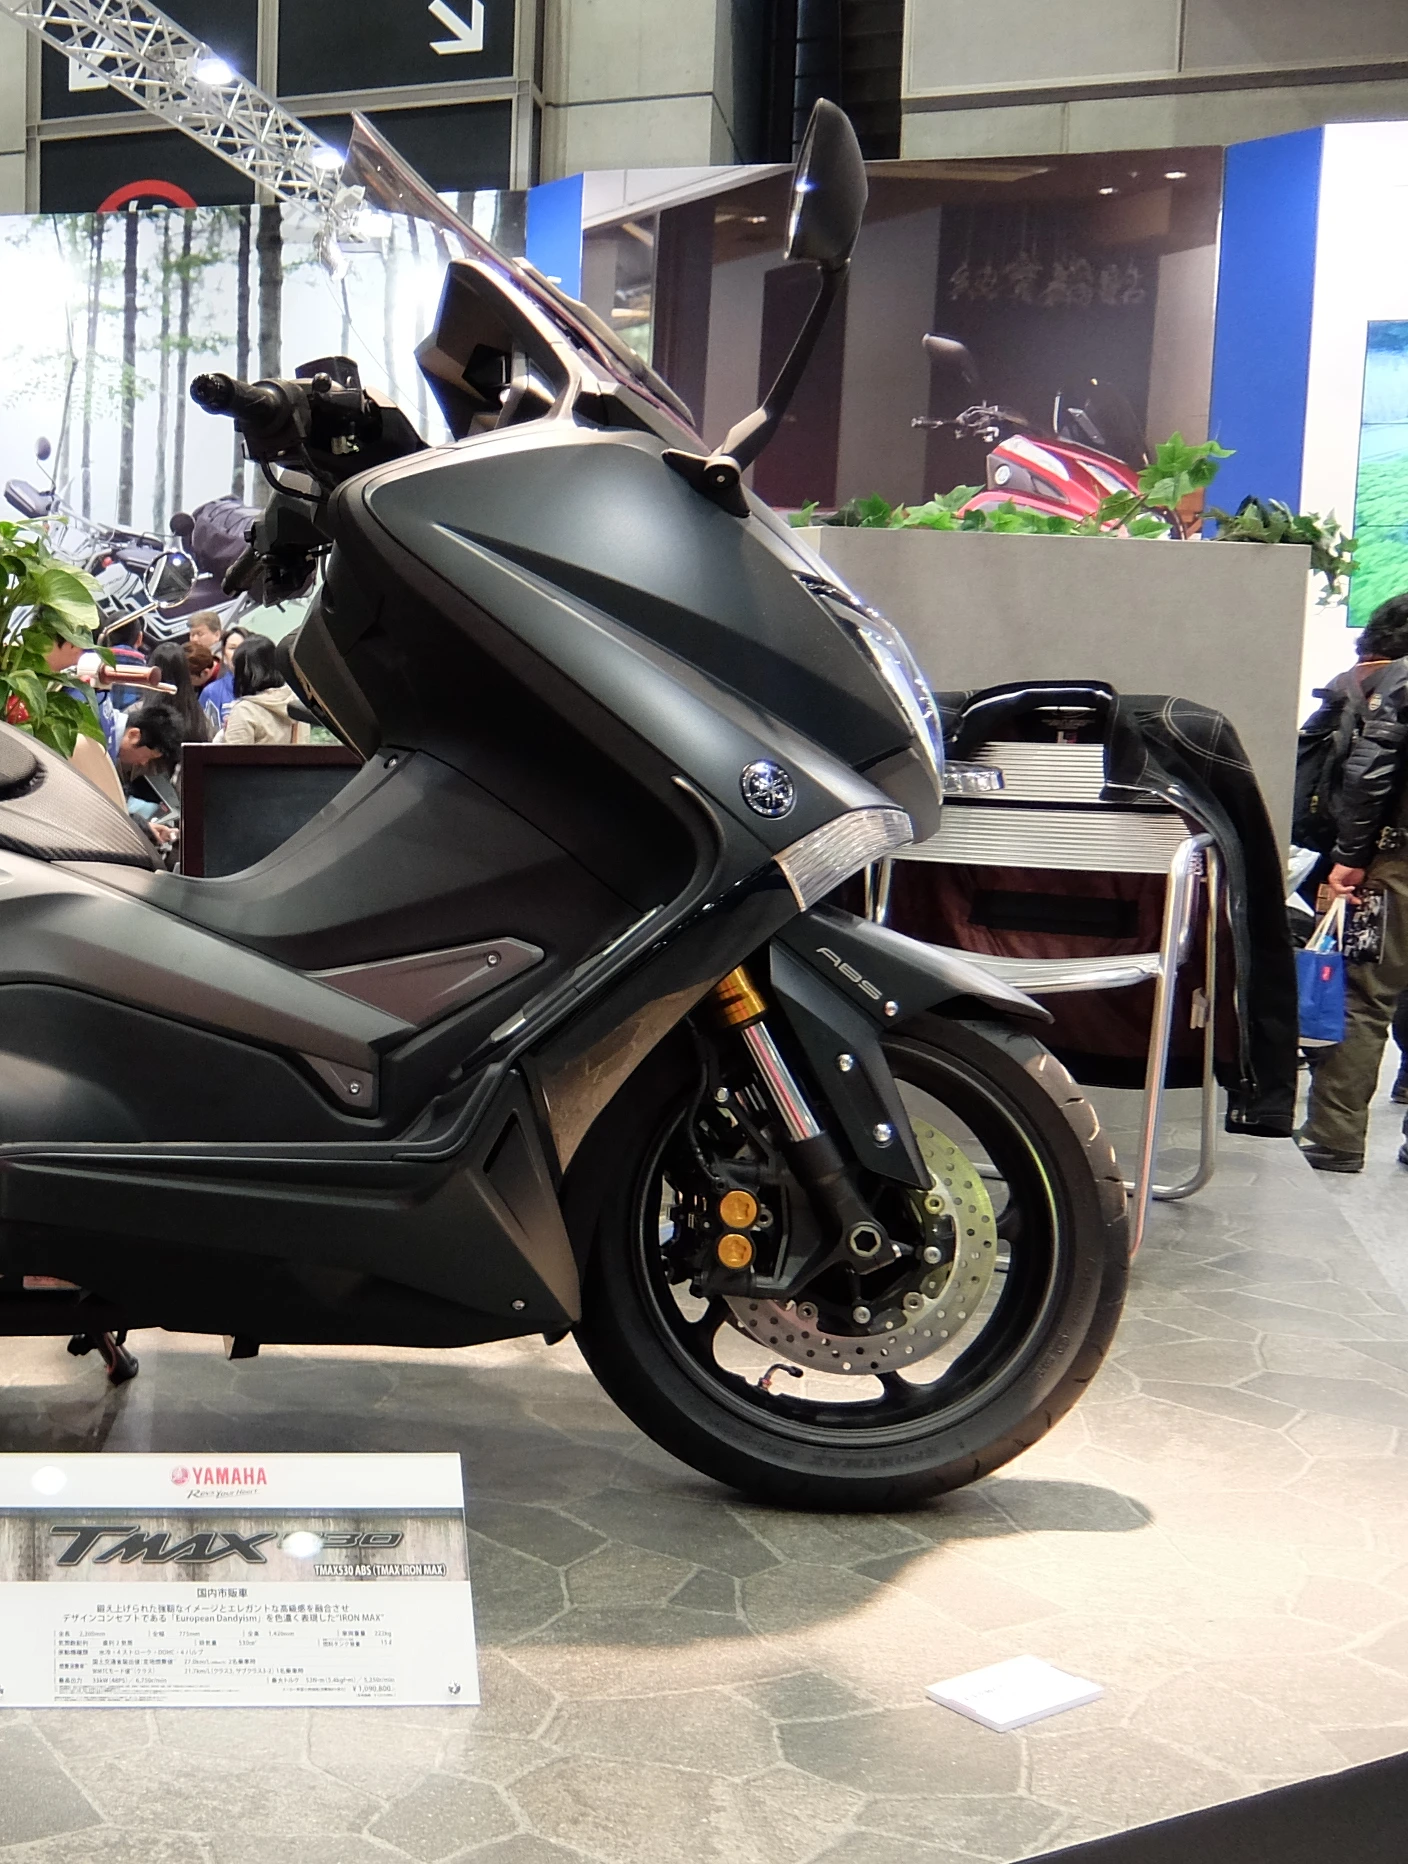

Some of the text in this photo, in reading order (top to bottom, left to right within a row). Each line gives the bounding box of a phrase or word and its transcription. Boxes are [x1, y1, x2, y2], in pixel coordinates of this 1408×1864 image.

[816, 947, 883, 1000] ABS
[192, 1467, 267, 1485] YAMAHA
[49, 1525, 278, 1566] TMAX
[314, 1564, 354, 1576] TMAX530
[355, 1564, 371, 1576] ABS
[402, 1564, 422, 1576] IRON
[424, 1564, 447, 1577] MAX)
[197, 1588, 248, 1599] 国内市販車
